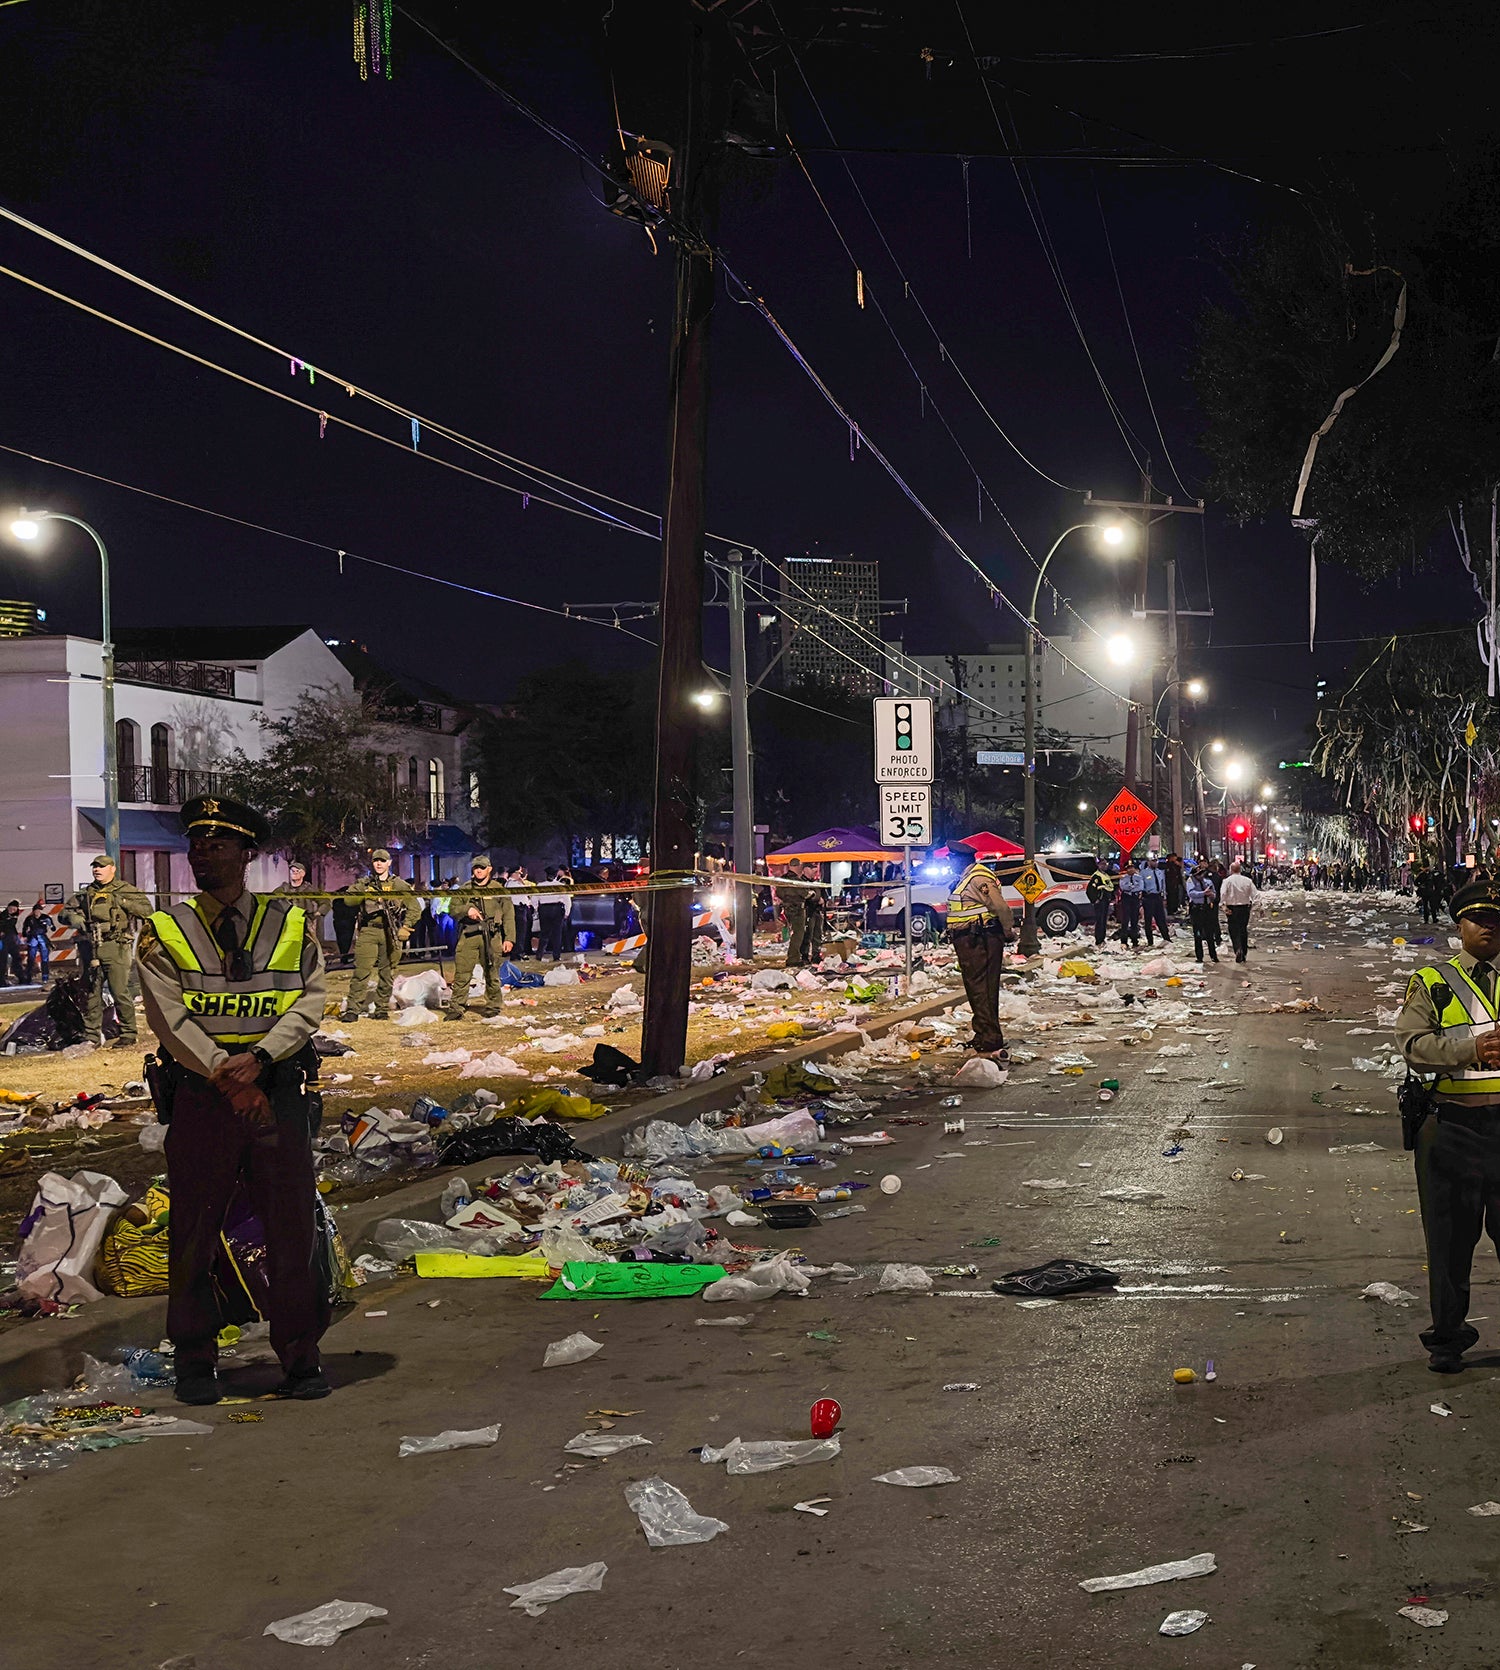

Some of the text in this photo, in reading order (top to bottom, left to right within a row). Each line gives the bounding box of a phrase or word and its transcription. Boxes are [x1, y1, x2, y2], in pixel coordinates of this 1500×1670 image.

[890, 755, 919, 764] PHOTO
[880, 767, 928, 777] ENFORCED
[885, 792, 926, 802] SPEED
[889, 804, 921, 813] LIMIT
[1113, 803, 1138, 812] ROAD
[1114, 816, 1138, 824] WORK
[889, 817, 923, 838] 35
[1113, 827, 1142, 836] AHEAD
